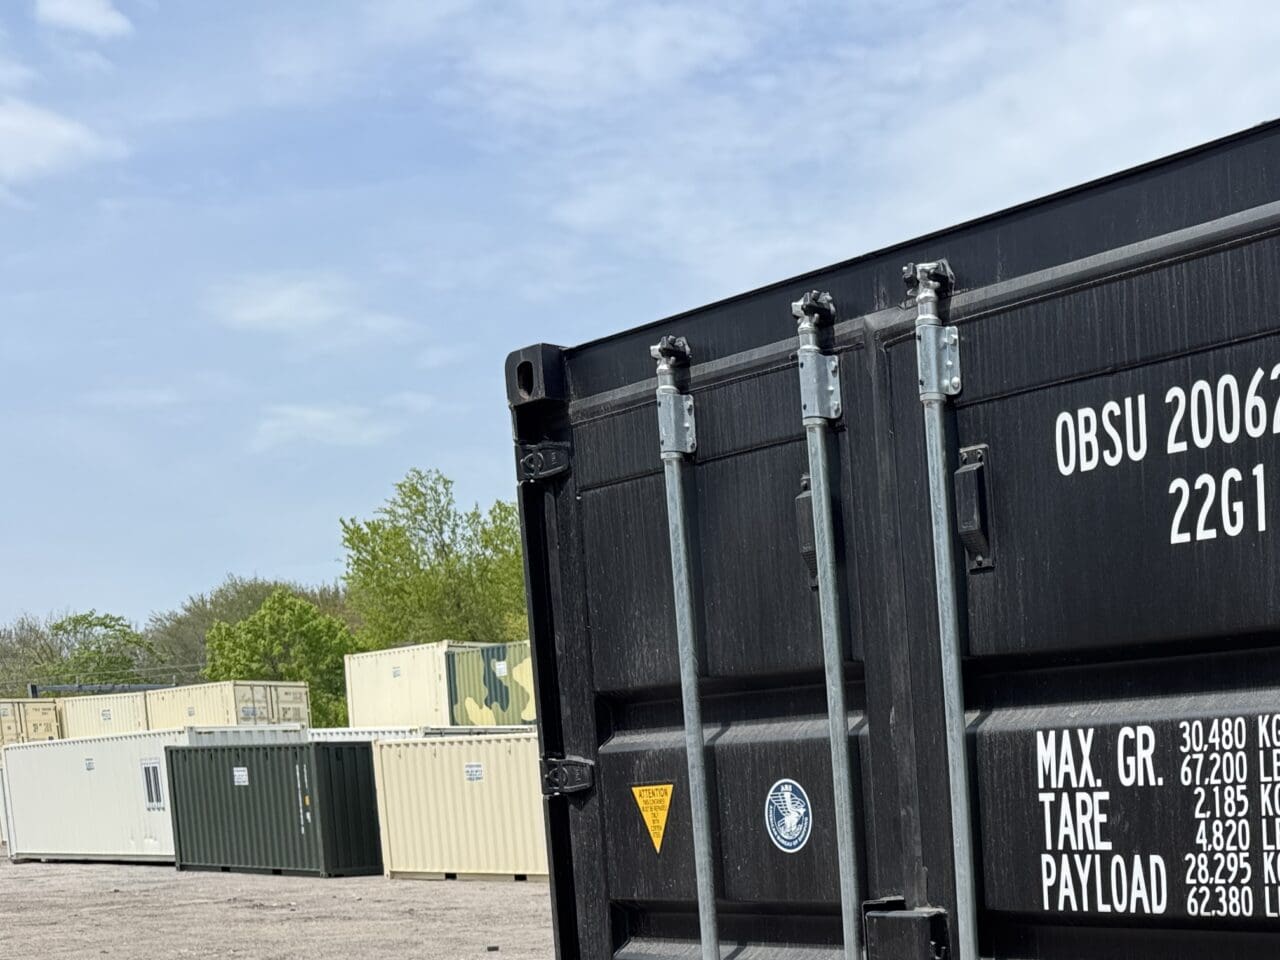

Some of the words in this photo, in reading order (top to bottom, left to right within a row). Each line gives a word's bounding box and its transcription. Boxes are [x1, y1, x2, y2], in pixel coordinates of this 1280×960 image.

[1055, 394, 1147, 476] OBSU
[1168, 463, 1266, 545] 22G1
[1036, 728, 1102, 789] MAX.
[1117, 725, 1164, 786] GR.
[1179, 717, 1247, 752] 30,480
[1180, 751, 1248, 786] 67,200
[1038, 791, 1112, 850] TARE
[1194, 785, 1249, 819] 2,185
[1195, 819, 1250, 851] 4,820
[1041, 853, 1167, 914] PAYLOAD
[1184, 852, 1251, 885] 28,295
